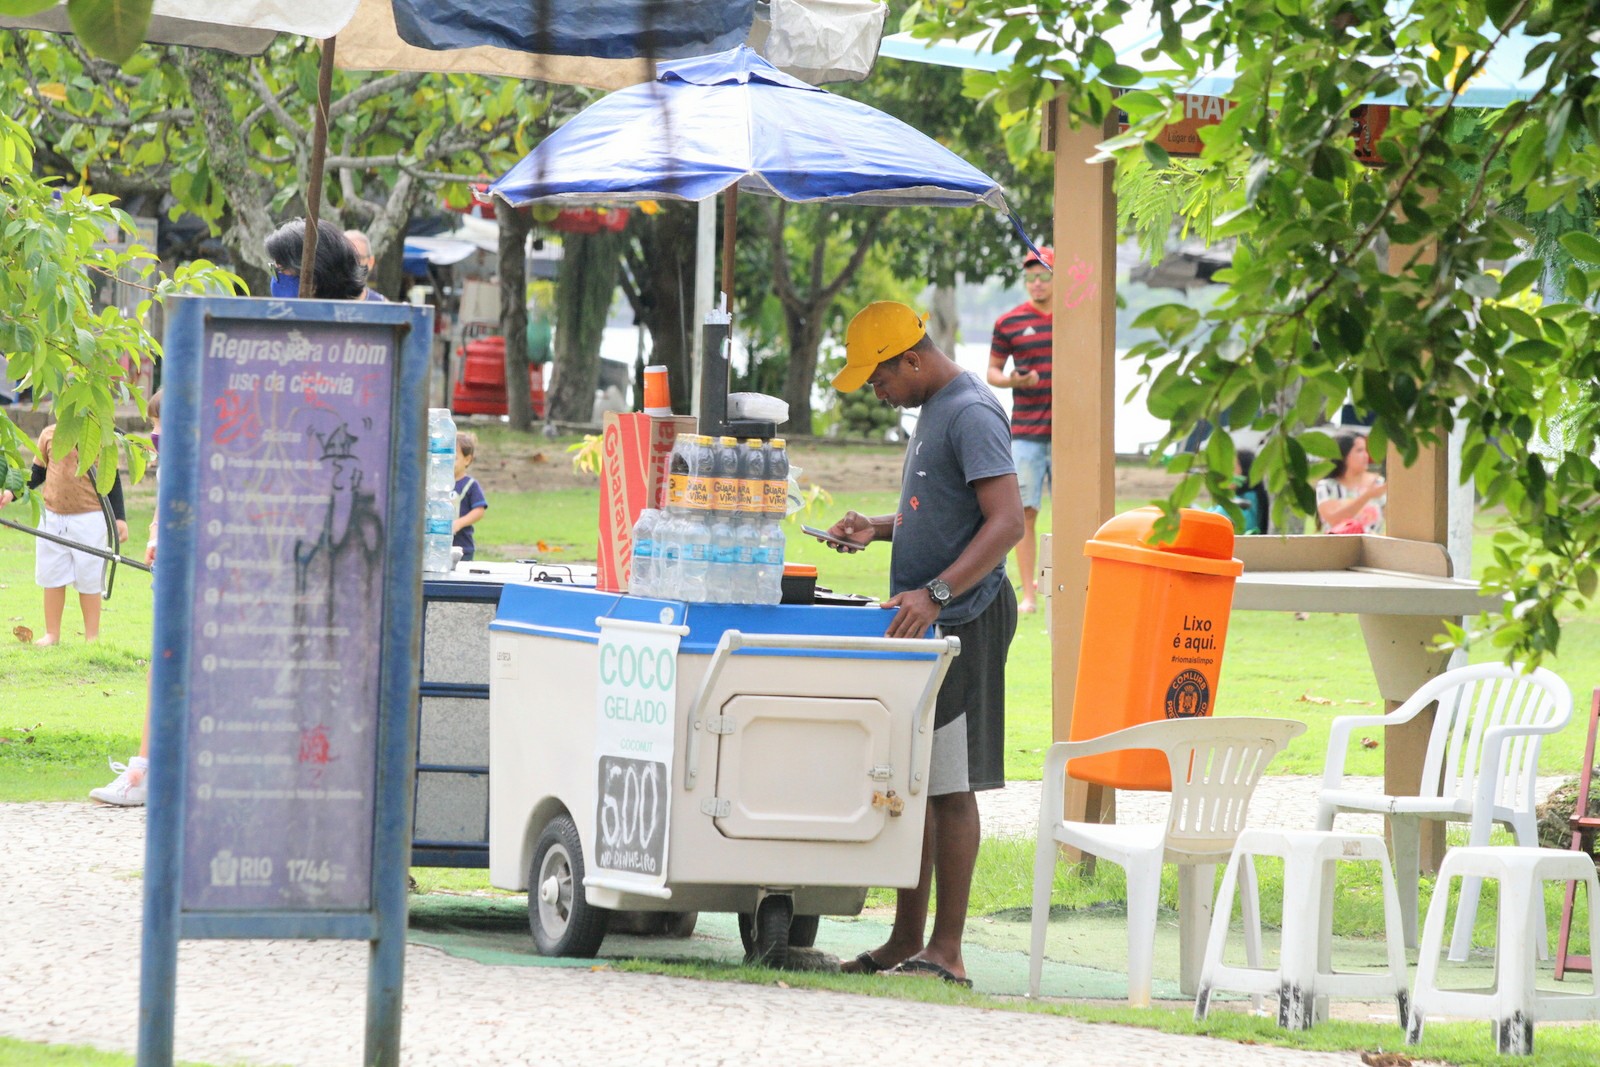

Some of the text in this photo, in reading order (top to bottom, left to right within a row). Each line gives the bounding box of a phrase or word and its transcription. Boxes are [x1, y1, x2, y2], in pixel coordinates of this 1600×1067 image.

[209, 331, 282, 365] Regras
[328, 344, 339, 364] o
[342, 337, 387, 365] bom
[228, 370, 355, 395] uso da ciclovia
[1183, 615, 1212, 632] Lixo
[1173, 632, 1216, 653] é aqui.
[600, 642, 675, 692] COCO
[1171, 655, 1214, 666] #riomaislimpo
[1172, 671, 1207, 690] COMLURB
[604, 695, 667, 726] GELADO
[620, 738, 653, 753] COCONUT
[240, 856, 273, 880] RIO
[286, 859, 331, 883] 1746
[613, 850, 656, 873] DINHEIRO
